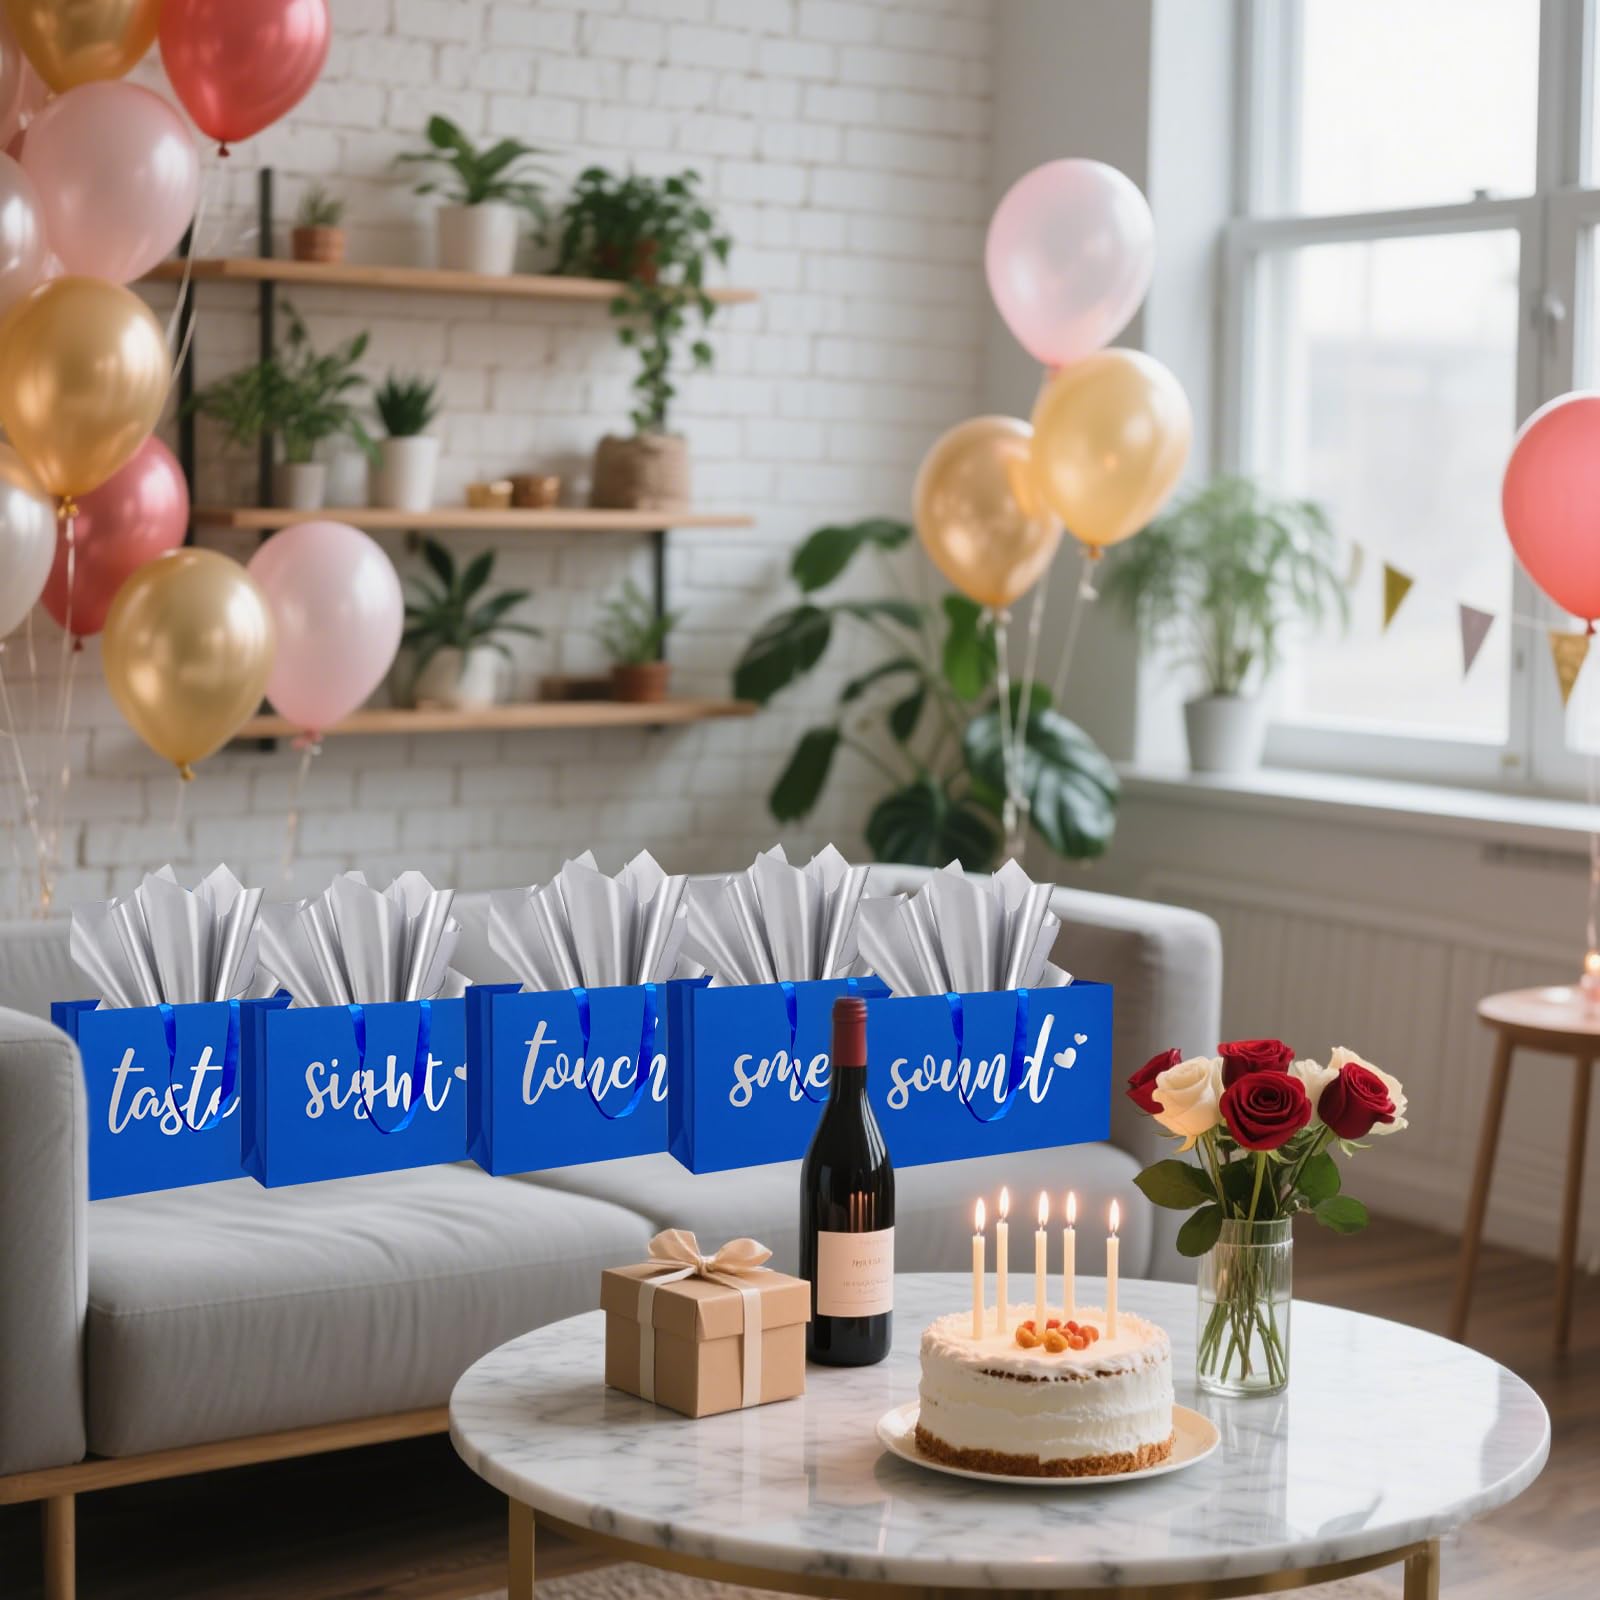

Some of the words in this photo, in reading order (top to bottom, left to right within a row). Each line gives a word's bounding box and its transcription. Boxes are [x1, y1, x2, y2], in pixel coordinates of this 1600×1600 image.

[305, 1053, 452, 1119] sight
[729, 1050, 832, 1108] sme
[886, 1013, 1055, 1110] sound
